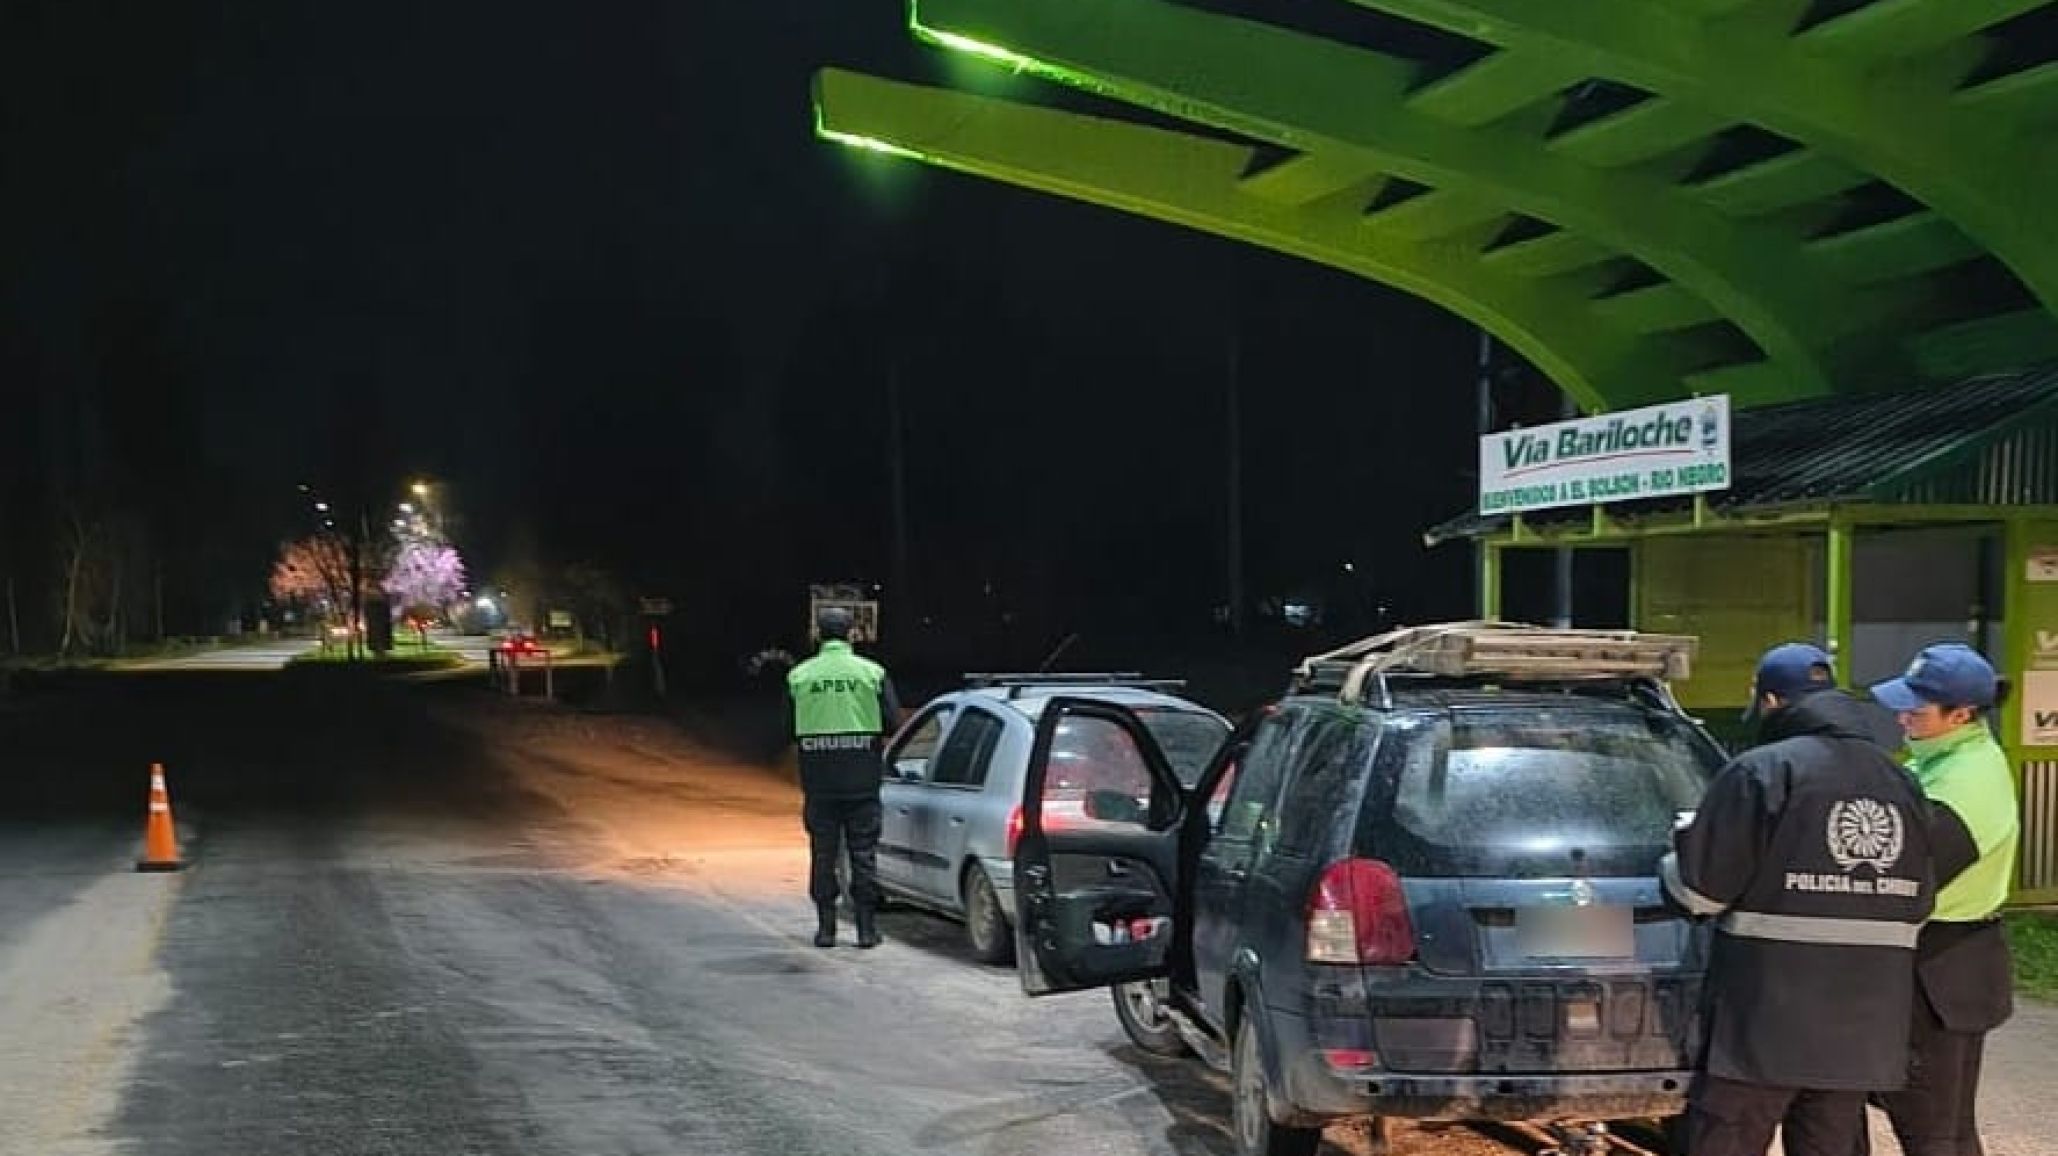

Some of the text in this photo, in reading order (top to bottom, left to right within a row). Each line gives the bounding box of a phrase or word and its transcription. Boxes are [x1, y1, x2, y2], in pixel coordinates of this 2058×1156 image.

[1504, 412, 1692, 468] Via Bariloche
[1559, 483, 1567, 500] A
[1571, 481, 1586, 500] EL
[1652, 469, 1673, 488] RIO
[1678, 462, 1725, 484] NEGRO
[810, 680, 857, 693] APSV
[802, 736, 870, 750] CHUBUT
[1784, 872, 1850, 892] POLICIA
